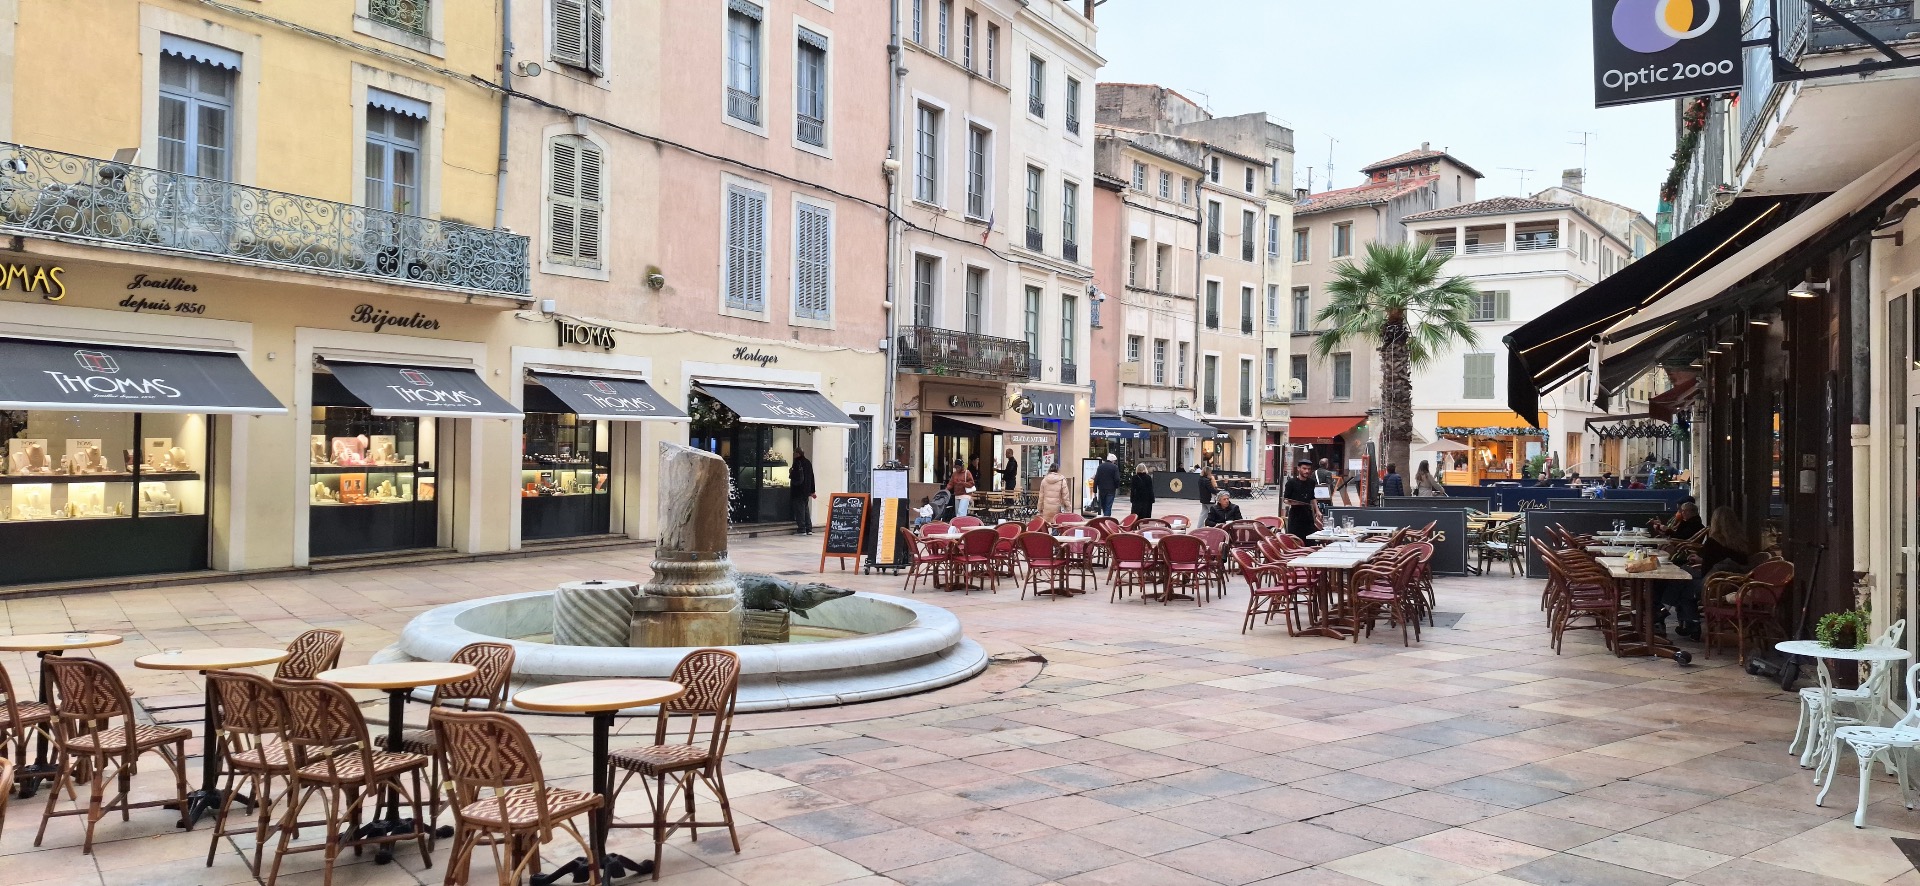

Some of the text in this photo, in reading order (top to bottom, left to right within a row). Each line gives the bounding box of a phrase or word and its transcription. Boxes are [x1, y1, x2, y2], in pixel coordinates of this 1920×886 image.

[1602, 58, 1734, 92] Optic 2000
[0, 262, 66, 301] MAS
[127, 273, 199, 293] Joaillier
[118, 294, 206, 315] depuis 1850
[350, 303, 441, 333] Bijoutier
[556, 320, 618, 351] THOMAS
[732, 346, 779, 368] Horloger
[43, 370, 182, 398] THOMAS
[386, 385, 482, 406] THOMAS
[582, 393, 656, 411] THOMAS
